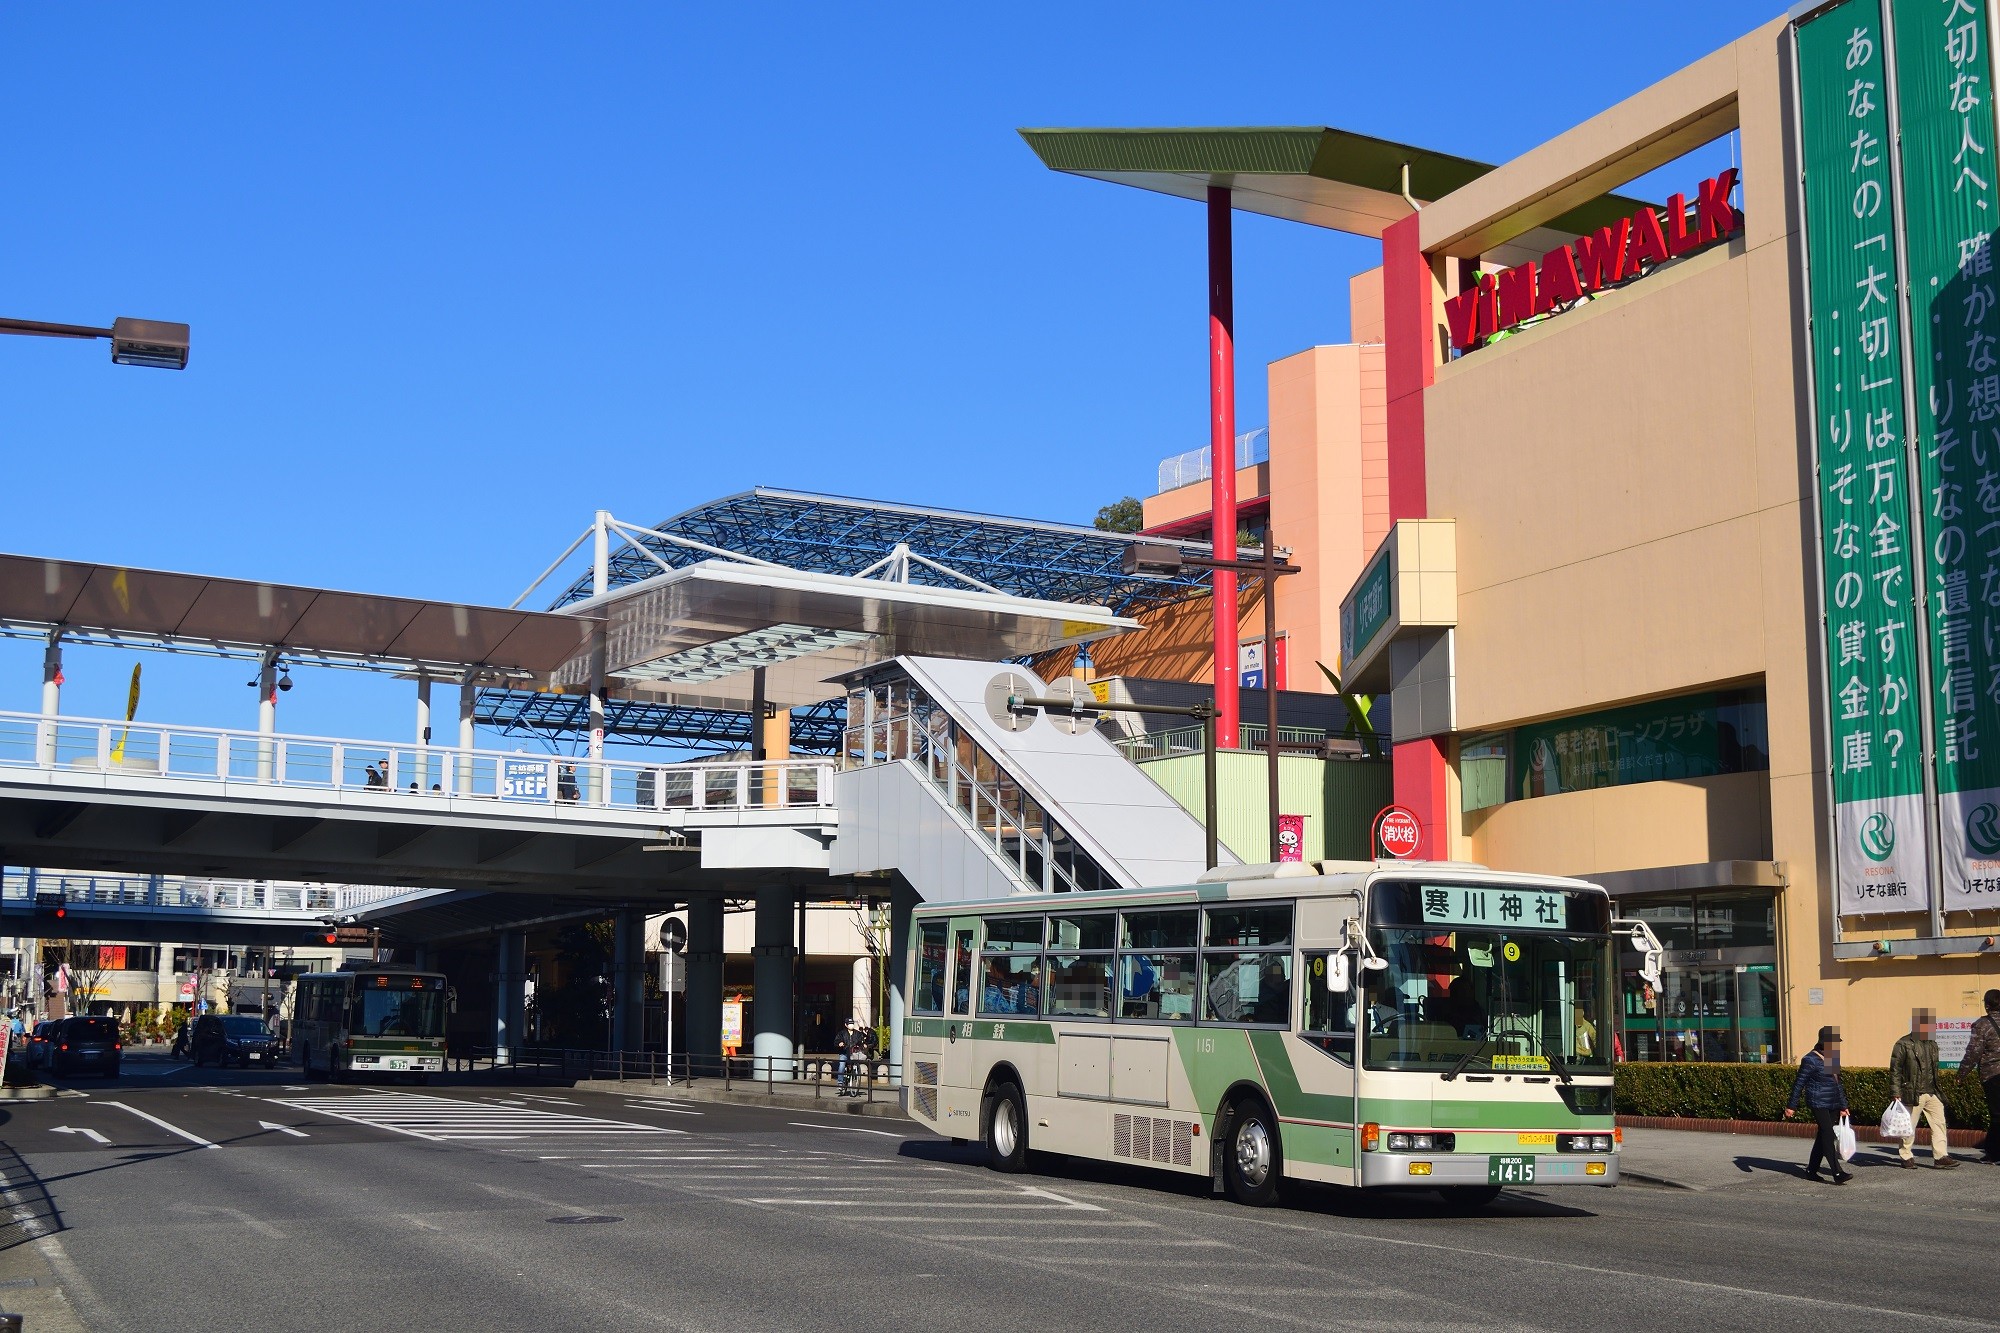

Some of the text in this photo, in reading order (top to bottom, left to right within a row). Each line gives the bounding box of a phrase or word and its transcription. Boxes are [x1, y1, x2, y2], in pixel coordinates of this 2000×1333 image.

[1384, 825, 1414, 843] 消火栓
[1864, 866, 1895, 877] RESONA
[1856, 882, 1907, 899] りそな銀行
[1963, 877, 2000, 894] りそな
[1425, 889, 1559, 924] 寒川神社
[1508, 946, 1515, 957] 9
[911, 1021, 923, 1034] 1151
[961, 1022, 1005, 1040] 相鉄
[1196, 1038, 1215, 1053] 1151
